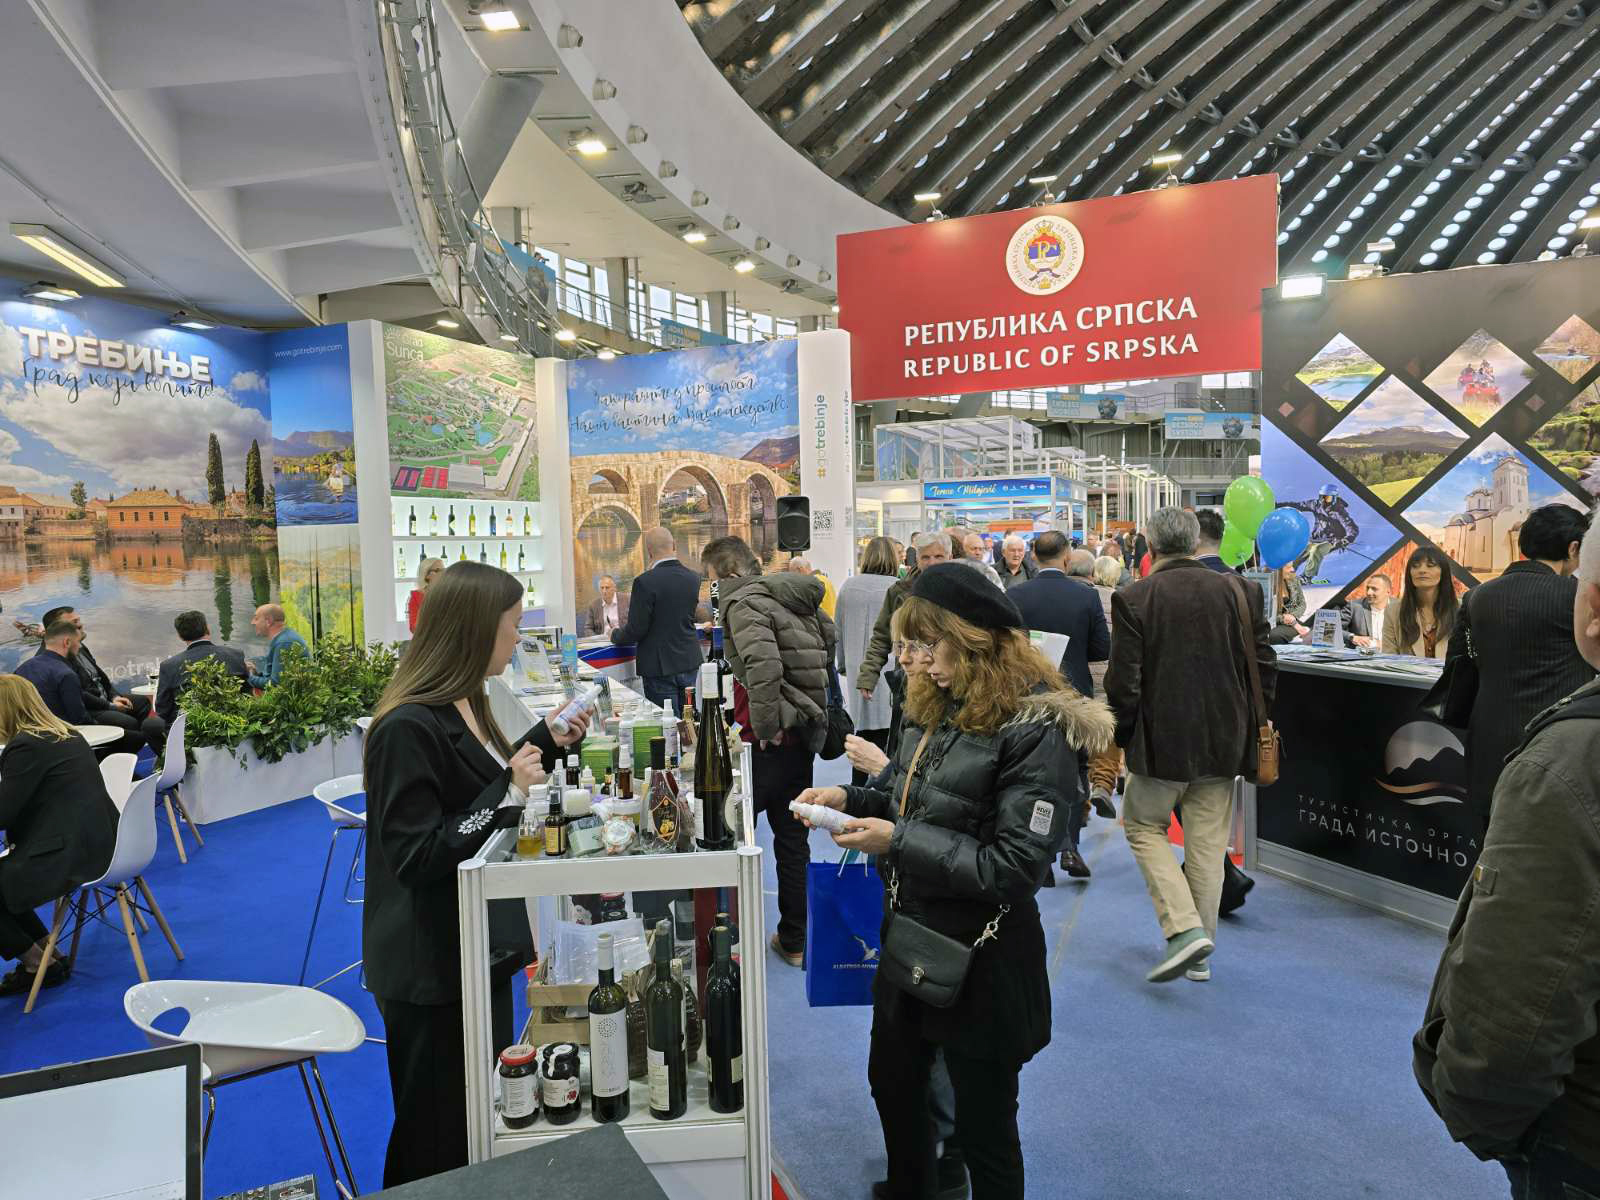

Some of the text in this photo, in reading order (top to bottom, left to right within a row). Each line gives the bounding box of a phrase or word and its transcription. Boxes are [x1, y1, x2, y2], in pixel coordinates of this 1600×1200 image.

[905, 296, 1198, 346] РЕПУБЛИКА СРПСКА
[18, 326, 211, 382] ТРЕБИЊЕ
[386, 342, 424, 361] Sunca
[904, 333, 1199, 378] REPUBLIC OF SRPSKA
[23, 357, 82, 404] Град
[815, 394, 827, 467] gotrebinje
[1298, 794, 1411, 831] ТУРИСТИЧКА
[1298, 809, 1468, 868] ГРАДА ИСТОЧНО
